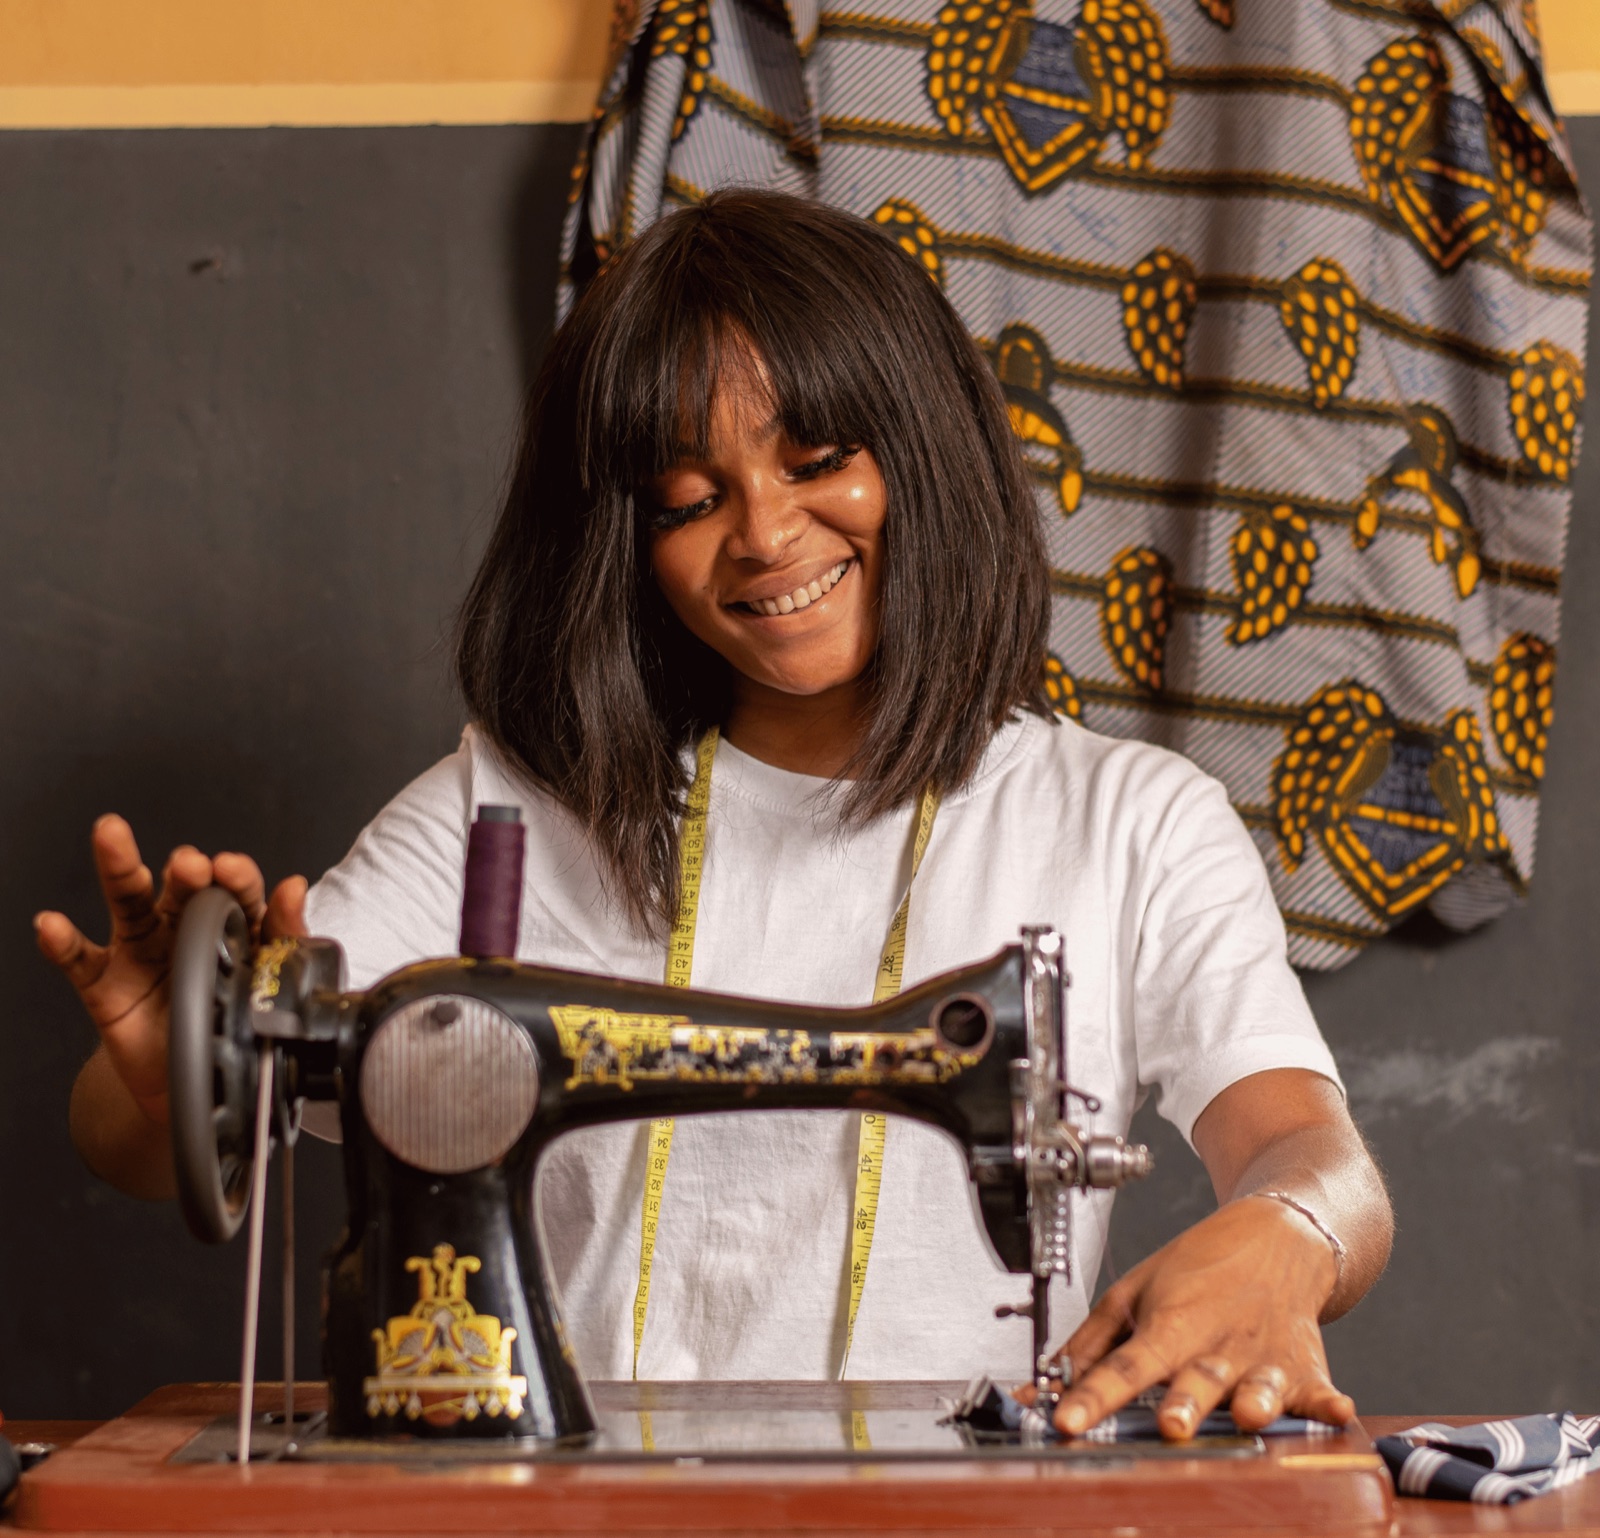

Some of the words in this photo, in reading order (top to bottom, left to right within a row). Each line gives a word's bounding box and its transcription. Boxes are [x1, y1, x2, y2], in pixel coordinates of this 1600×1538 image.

[691, 823, 703, 832] 51
[688, 839, 700, 848] 50
[686, 856, 699, 865] 49
[685, 872, 698, 881] 48
[682, 889, 696, 899] 47
[680, 906, 694, 916] 46
[679, 923, 692, 934] 45
[677, 941, 690, 951] 44
[675, 958, 688, 969] 43
[882, 955, 895, 974] 37
[673, 975, 686, 986] 42
[657, 1137, 669, 1149] 34
[654, 1158, 666, 1170] 33
[860, 1154, 872, 1174] 41
[651, 1178, 662, 1191] 32
[649, 1200, 659, 1212] 31
[856, 1207, 868, 1231] 42
[647, 1221, 656, 1233] 30
[645, 1242, 653, 1254] 29
[642, 1263, 650, 1276] 28
[853, 1261, 862, 1284] 43
[639, 1285, 647, 1297] 27
